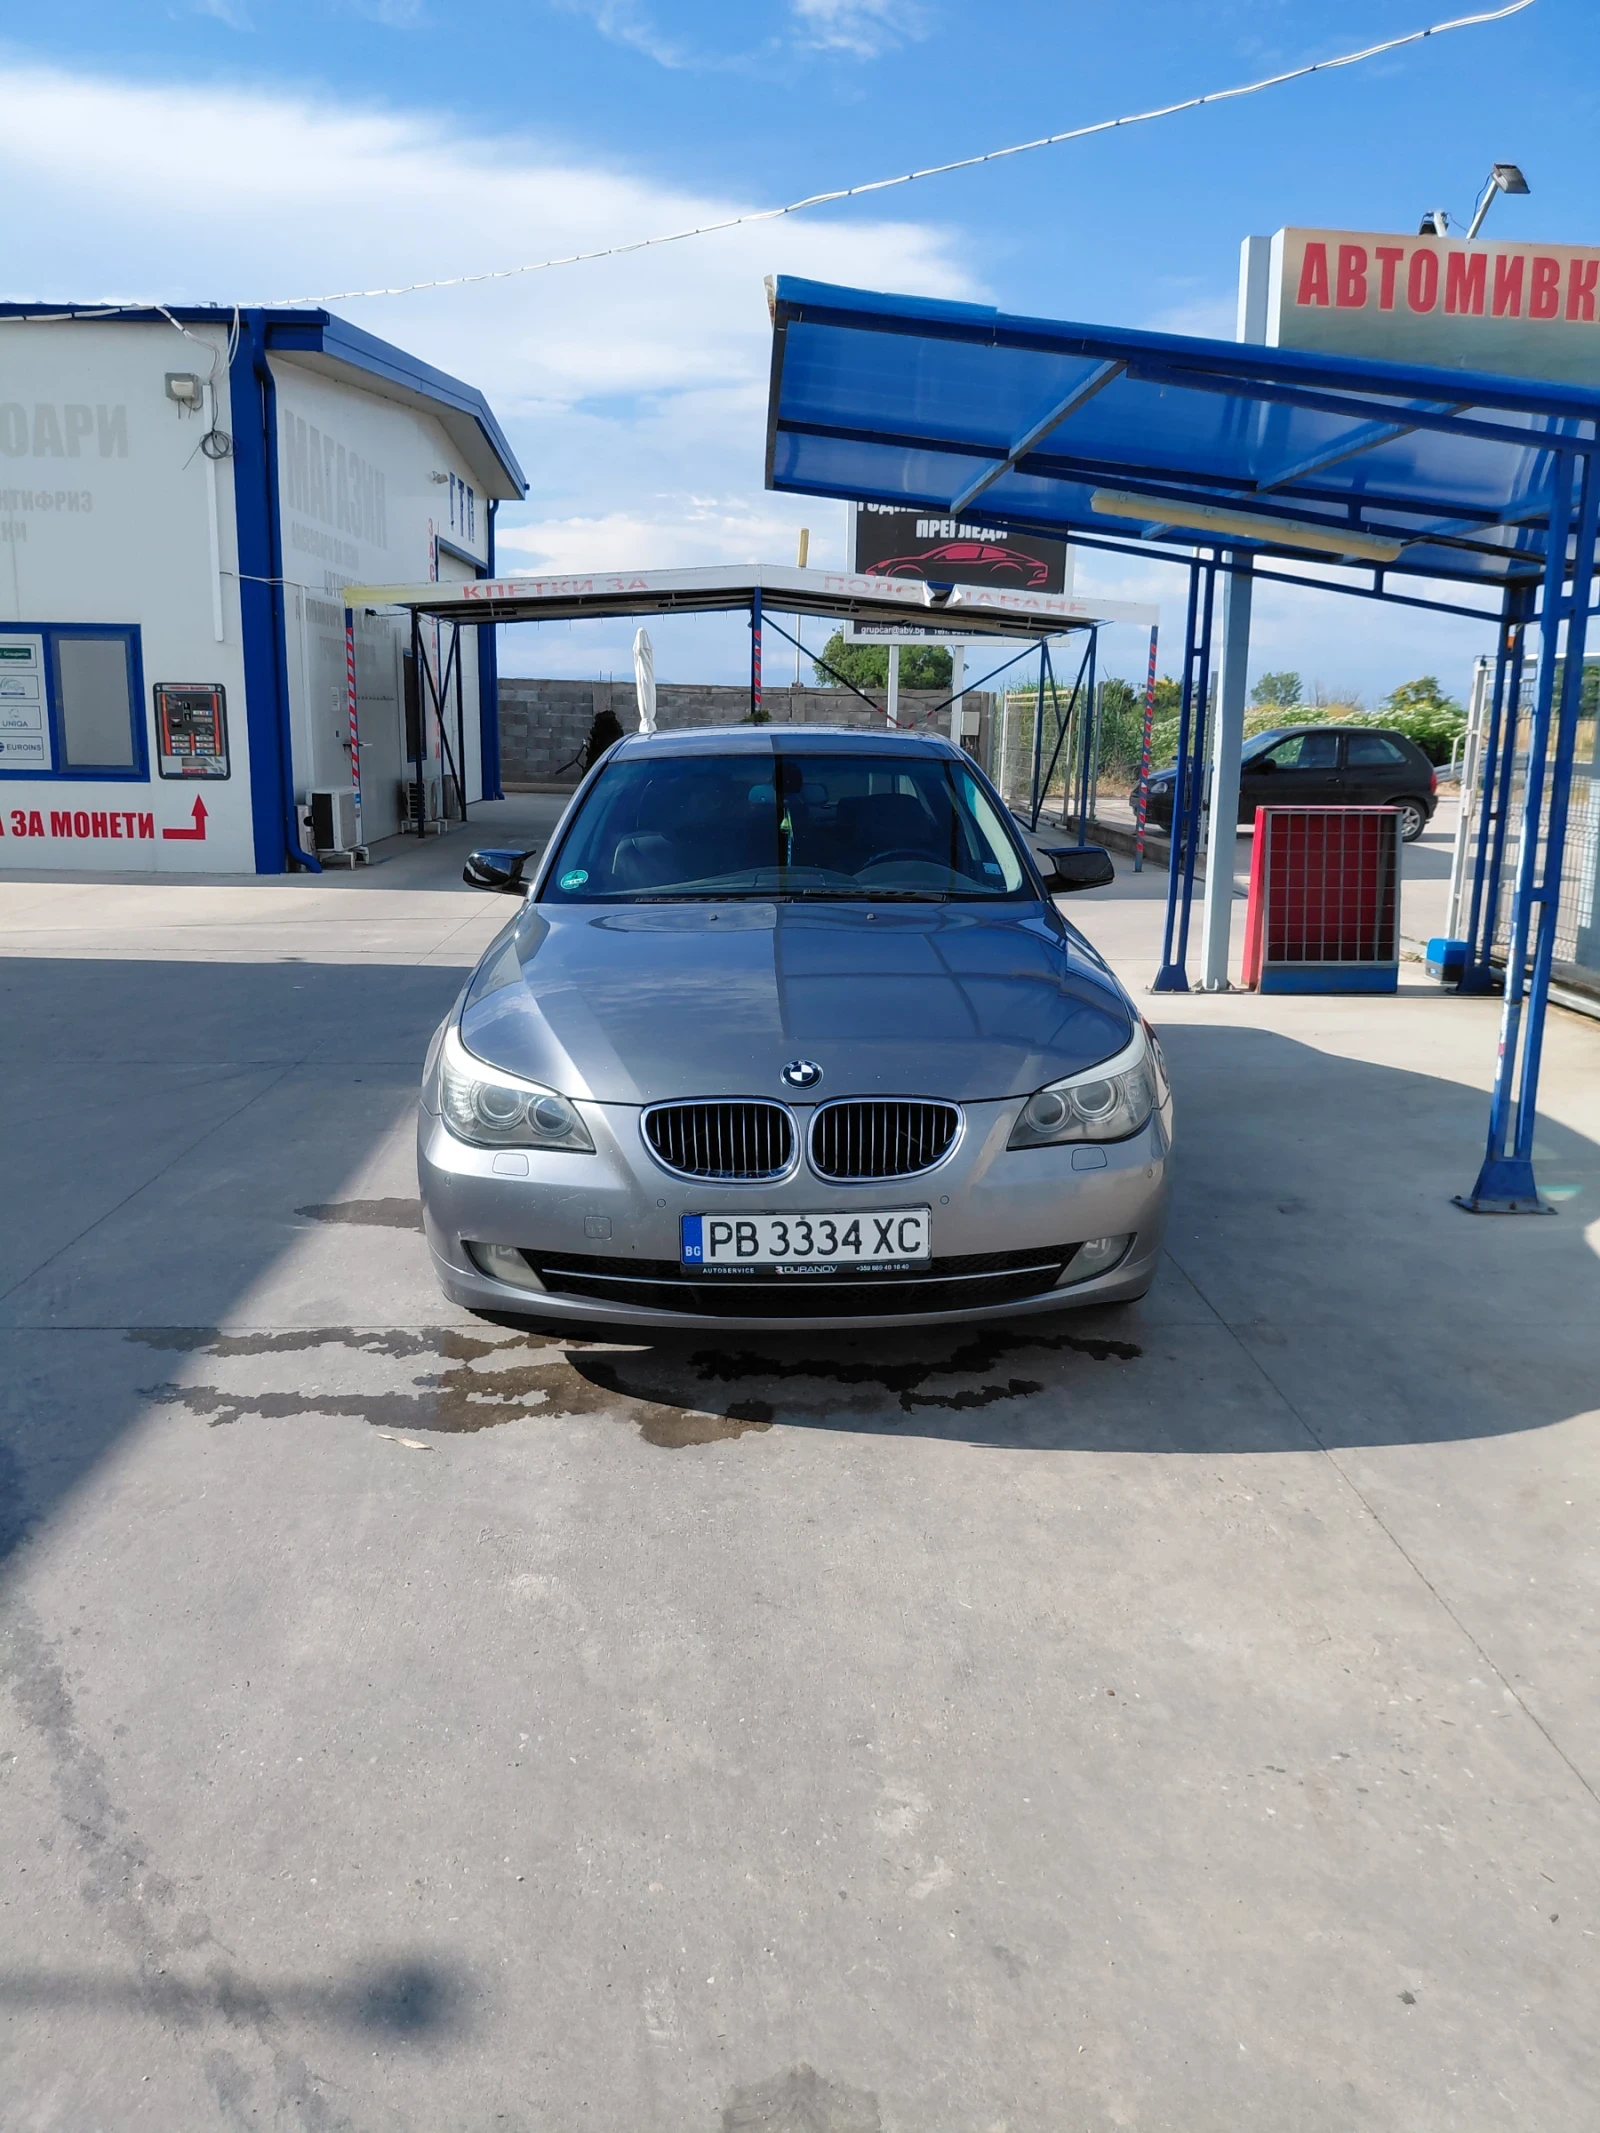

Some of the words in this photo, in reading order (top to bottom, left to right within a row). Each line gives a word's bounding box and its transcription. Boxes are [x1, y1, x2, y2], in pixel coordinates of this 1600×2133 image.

[1296, 242, 1600, 322] АВТОМИВК
[284, 408, 388, 552] МАГАЗИН
[606, 577, 649, 591] ЗА
[861, 626, 925, 636] grupcar@abv.bg
[2, 720, 28, 728] UNIQA
[6, 743, 41, 752] EUROINS
[10, 810, 45, 837] ЗА
[50, 811, 155, 839] МОНЕТИ
[709, 1221, 759, 1257] PB
[769, 1219, 862, 1256] 3334
[873, 1217, 921, 1254] XC
[685, 1246, 701, 1256] BG
